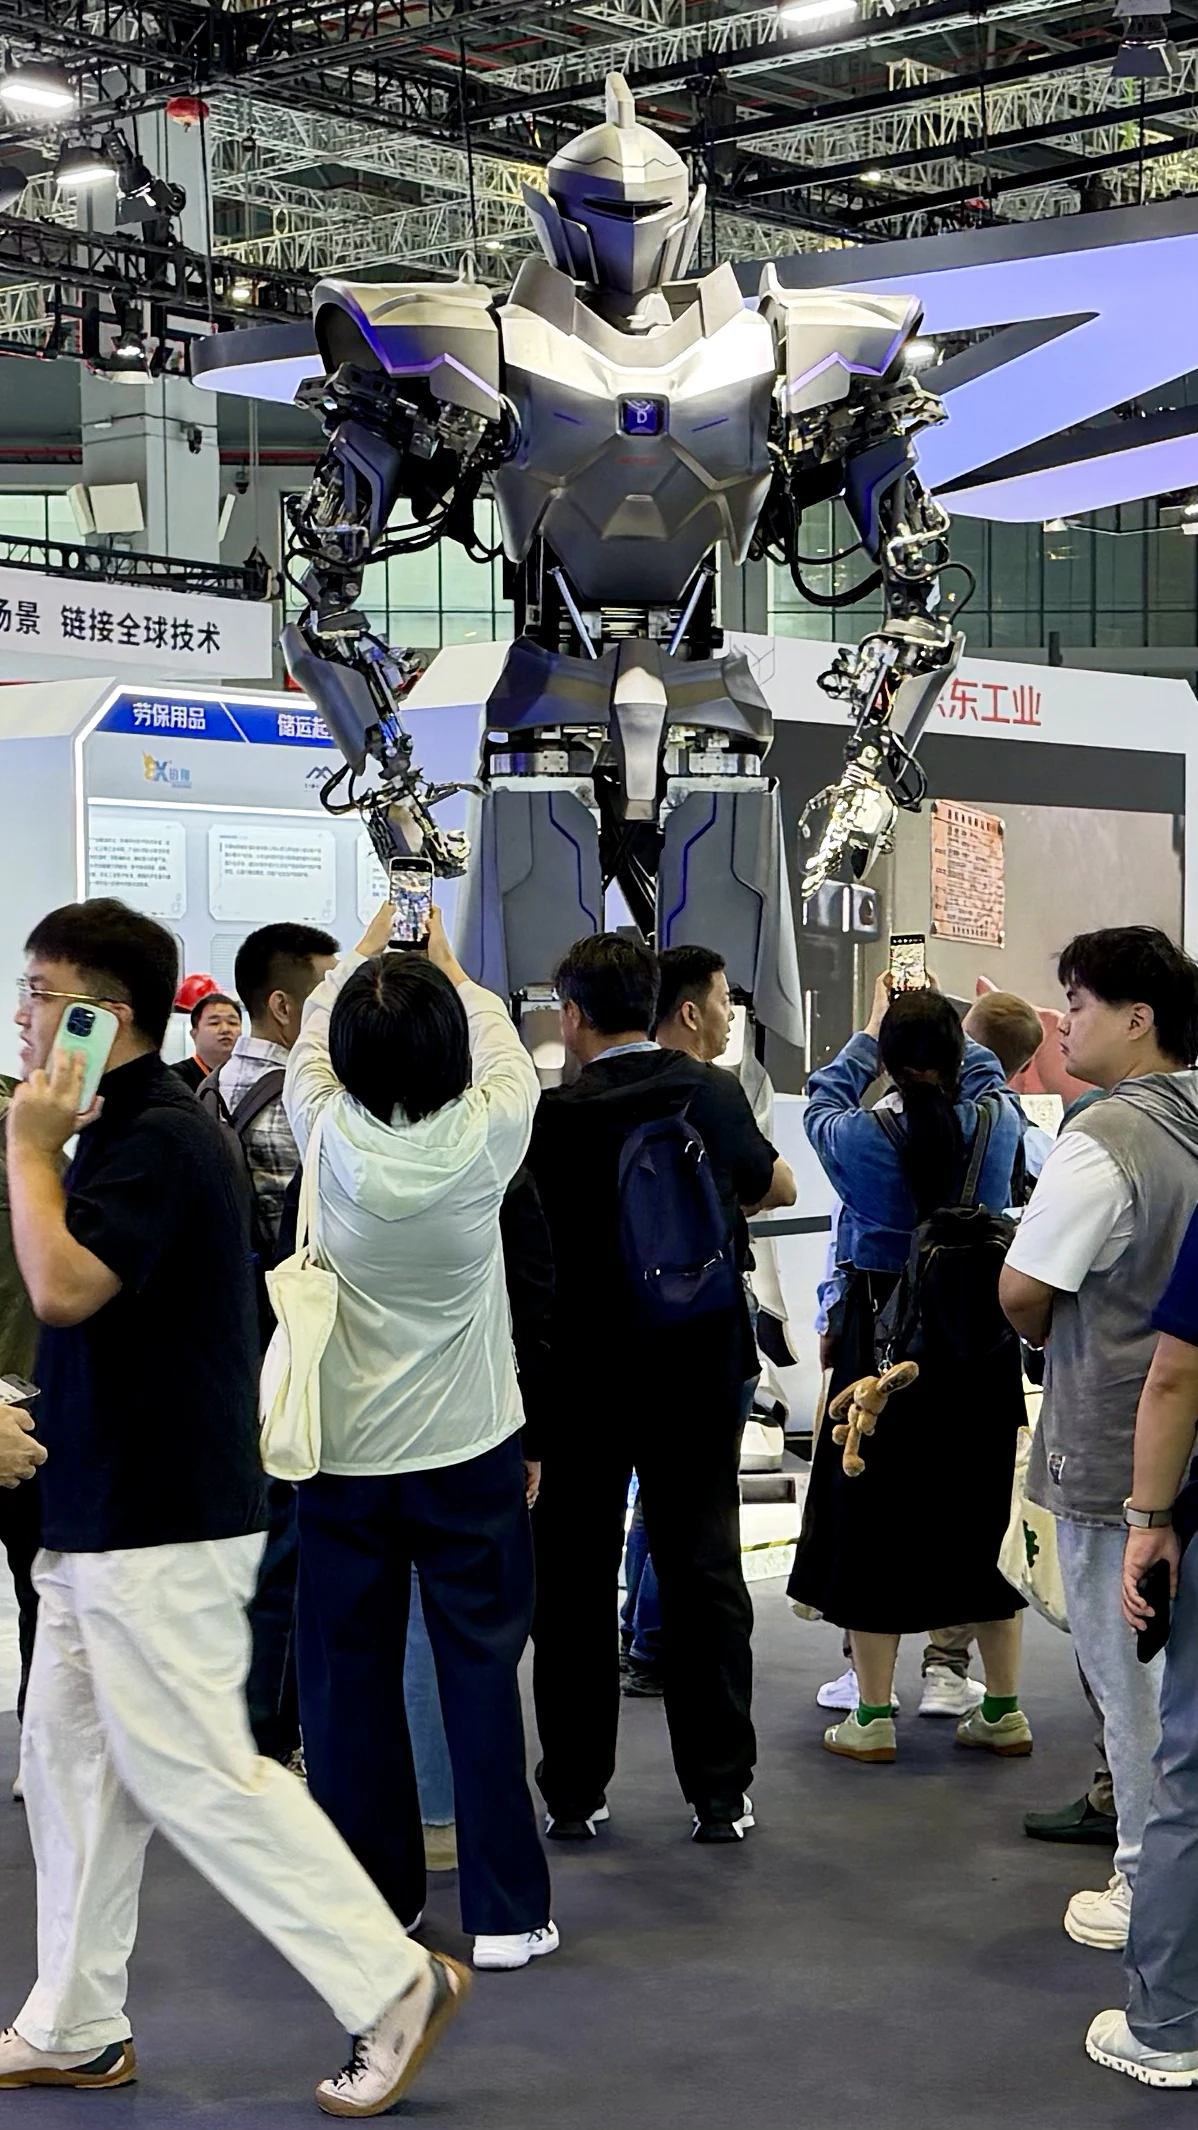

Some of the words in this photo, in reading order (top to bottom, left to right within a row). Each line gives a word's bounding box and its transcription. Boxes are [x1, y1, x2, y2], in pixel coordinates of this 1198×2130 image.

[61, 605, 221, 654] 链接全球技术
[133, 702, 206, 730] 劳保用品
[938, 678, 1042, 726] 东工业
